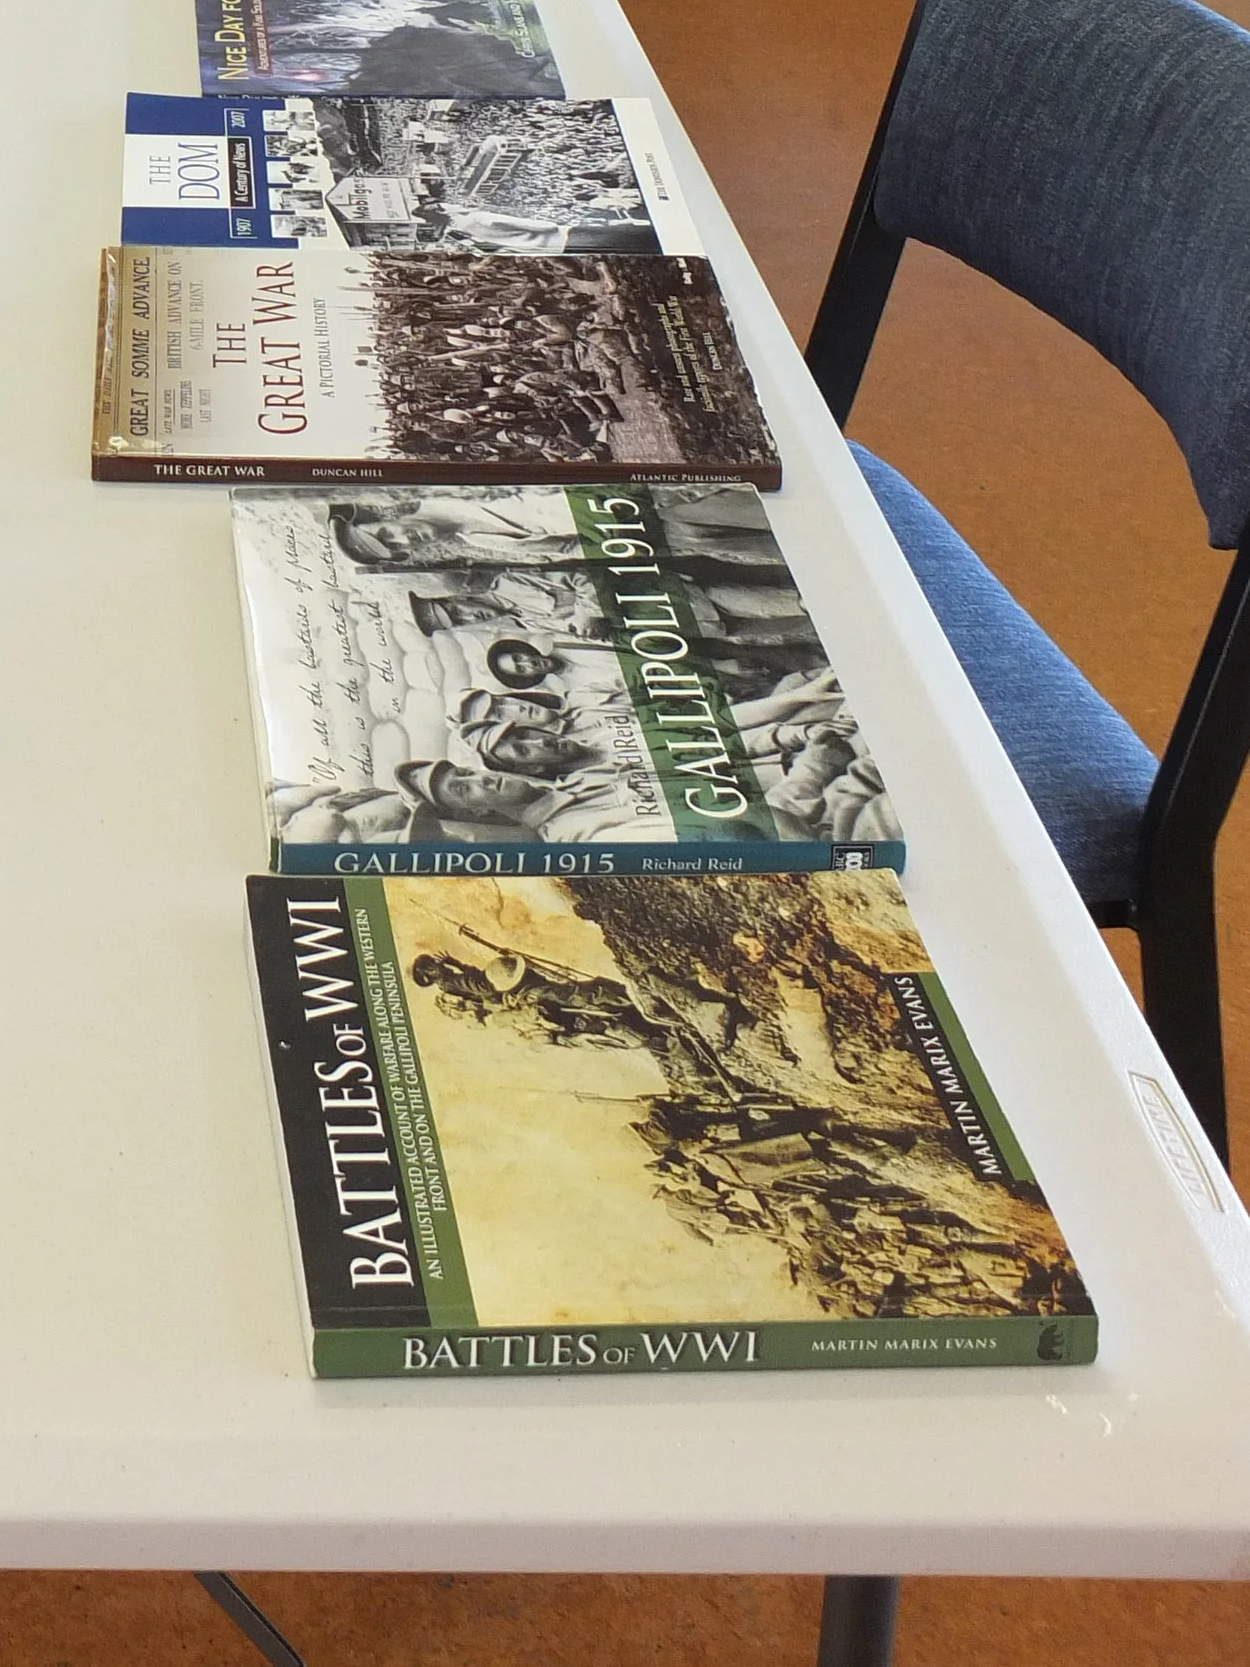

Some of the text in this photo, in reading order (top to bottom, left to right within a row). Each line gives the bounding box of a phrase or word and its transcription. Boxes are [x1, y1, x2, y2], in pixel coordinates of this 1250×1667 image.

[214, 17, 245, 43] DAY
[217, 46, 249, 79] NICE
[230, 111, 245, 128] 2007
[149, 156, 171, 184] THE
[233, 160, 247, 169] of
[234, 143, 246, 160] News
[178, 143, 220, 200] DOM
[234, 170, 250, 195] Century
[237, 218, 251, 236] 1907
[167, 261, 182, 370] BRITISH ADVANCE ON
[131, 329, 150, 378] SOMME
[212, 323, 247, 368] THE
[252, 261, 308, 435] GREAT WAR
[313, 298, 335, 398] A PICTORIAL HISTORY
[130, 389, 150, 436] GREAT
[154, 463, 741, 484] THE GREAT WAR DUNCAN HILL ATLANTIC PUBLISHING
[370, 658, 394, 685] the
[603, 496, 748, 820] GALLIPOLI 1915
[299, 682, 323, 708] the
[336, 678, 361, 705] the
[615, 714, 643, 760] Reid
[350, 743, 374, 777] this
[333, 851, 743, 875] GALLIPOLI 1915 Richard Reid
[286, 896, 415, 1289] BATTLES OF WWI
[382, 962, 449, 1213] FRONT AND ON THE GALLIPOLI PENINSULA
[892, 973, 1004, 1177] MARTIN MARIX EVANS
[354, 908, 444, 1280] AN ILLUSTRATED ACCOUNT OF WARFARE ALONG THE WESTERN
[403, 1332, 998, 1372] BATTLES OF WWI MARTIN MARIX EVANS
